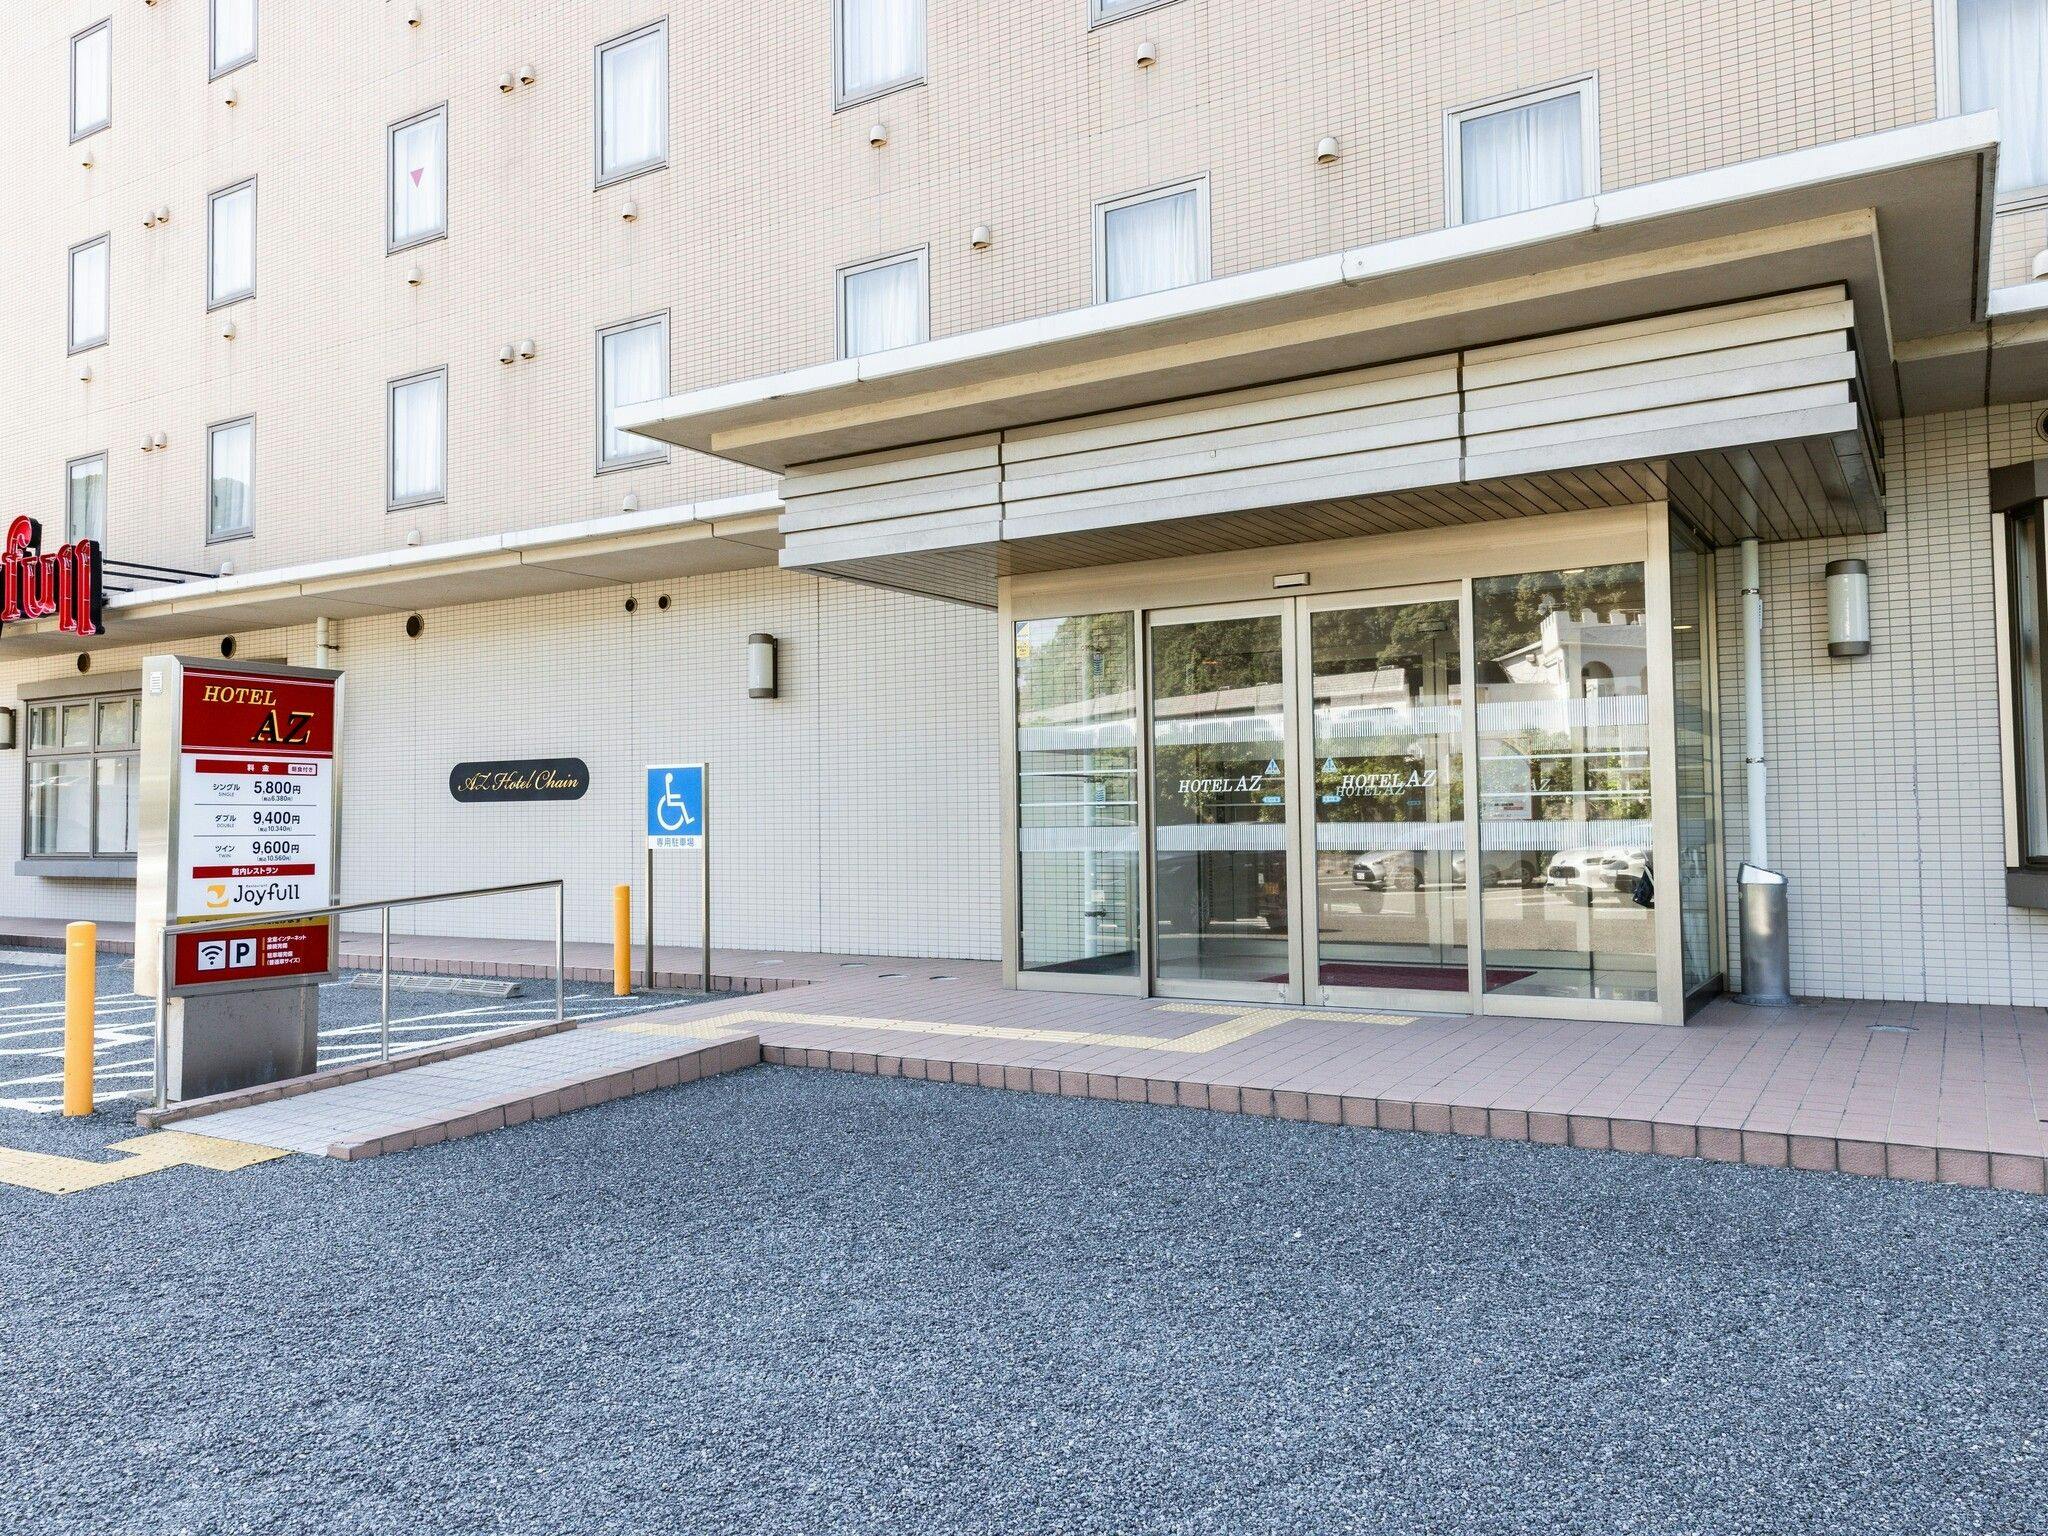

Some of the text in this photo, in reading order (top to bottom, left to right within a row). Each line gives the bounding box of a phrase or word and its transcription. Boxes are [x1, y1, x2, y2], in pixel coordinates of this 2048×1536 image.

[1, 515, 97, 636] full
[202, 685, 277, 706] HOTEL
[251, 709, 315, 745] AZ
[212, 783, 241, 791] シングル
[254, 781, 301, 795] 5,800円
[458, 770, 580, 791] AZ Hotel Chain
[1178, 775, 1263, 793] HOTEL AZ
[1342, 769, 1438, 788] HOTEL AZ
[253, 811, 301, 825] 9,400円
[252, 841, 300, 855] 9,600円
[233, 883, 300, 906] Joyfull
[236, 942, 250, 964] P
